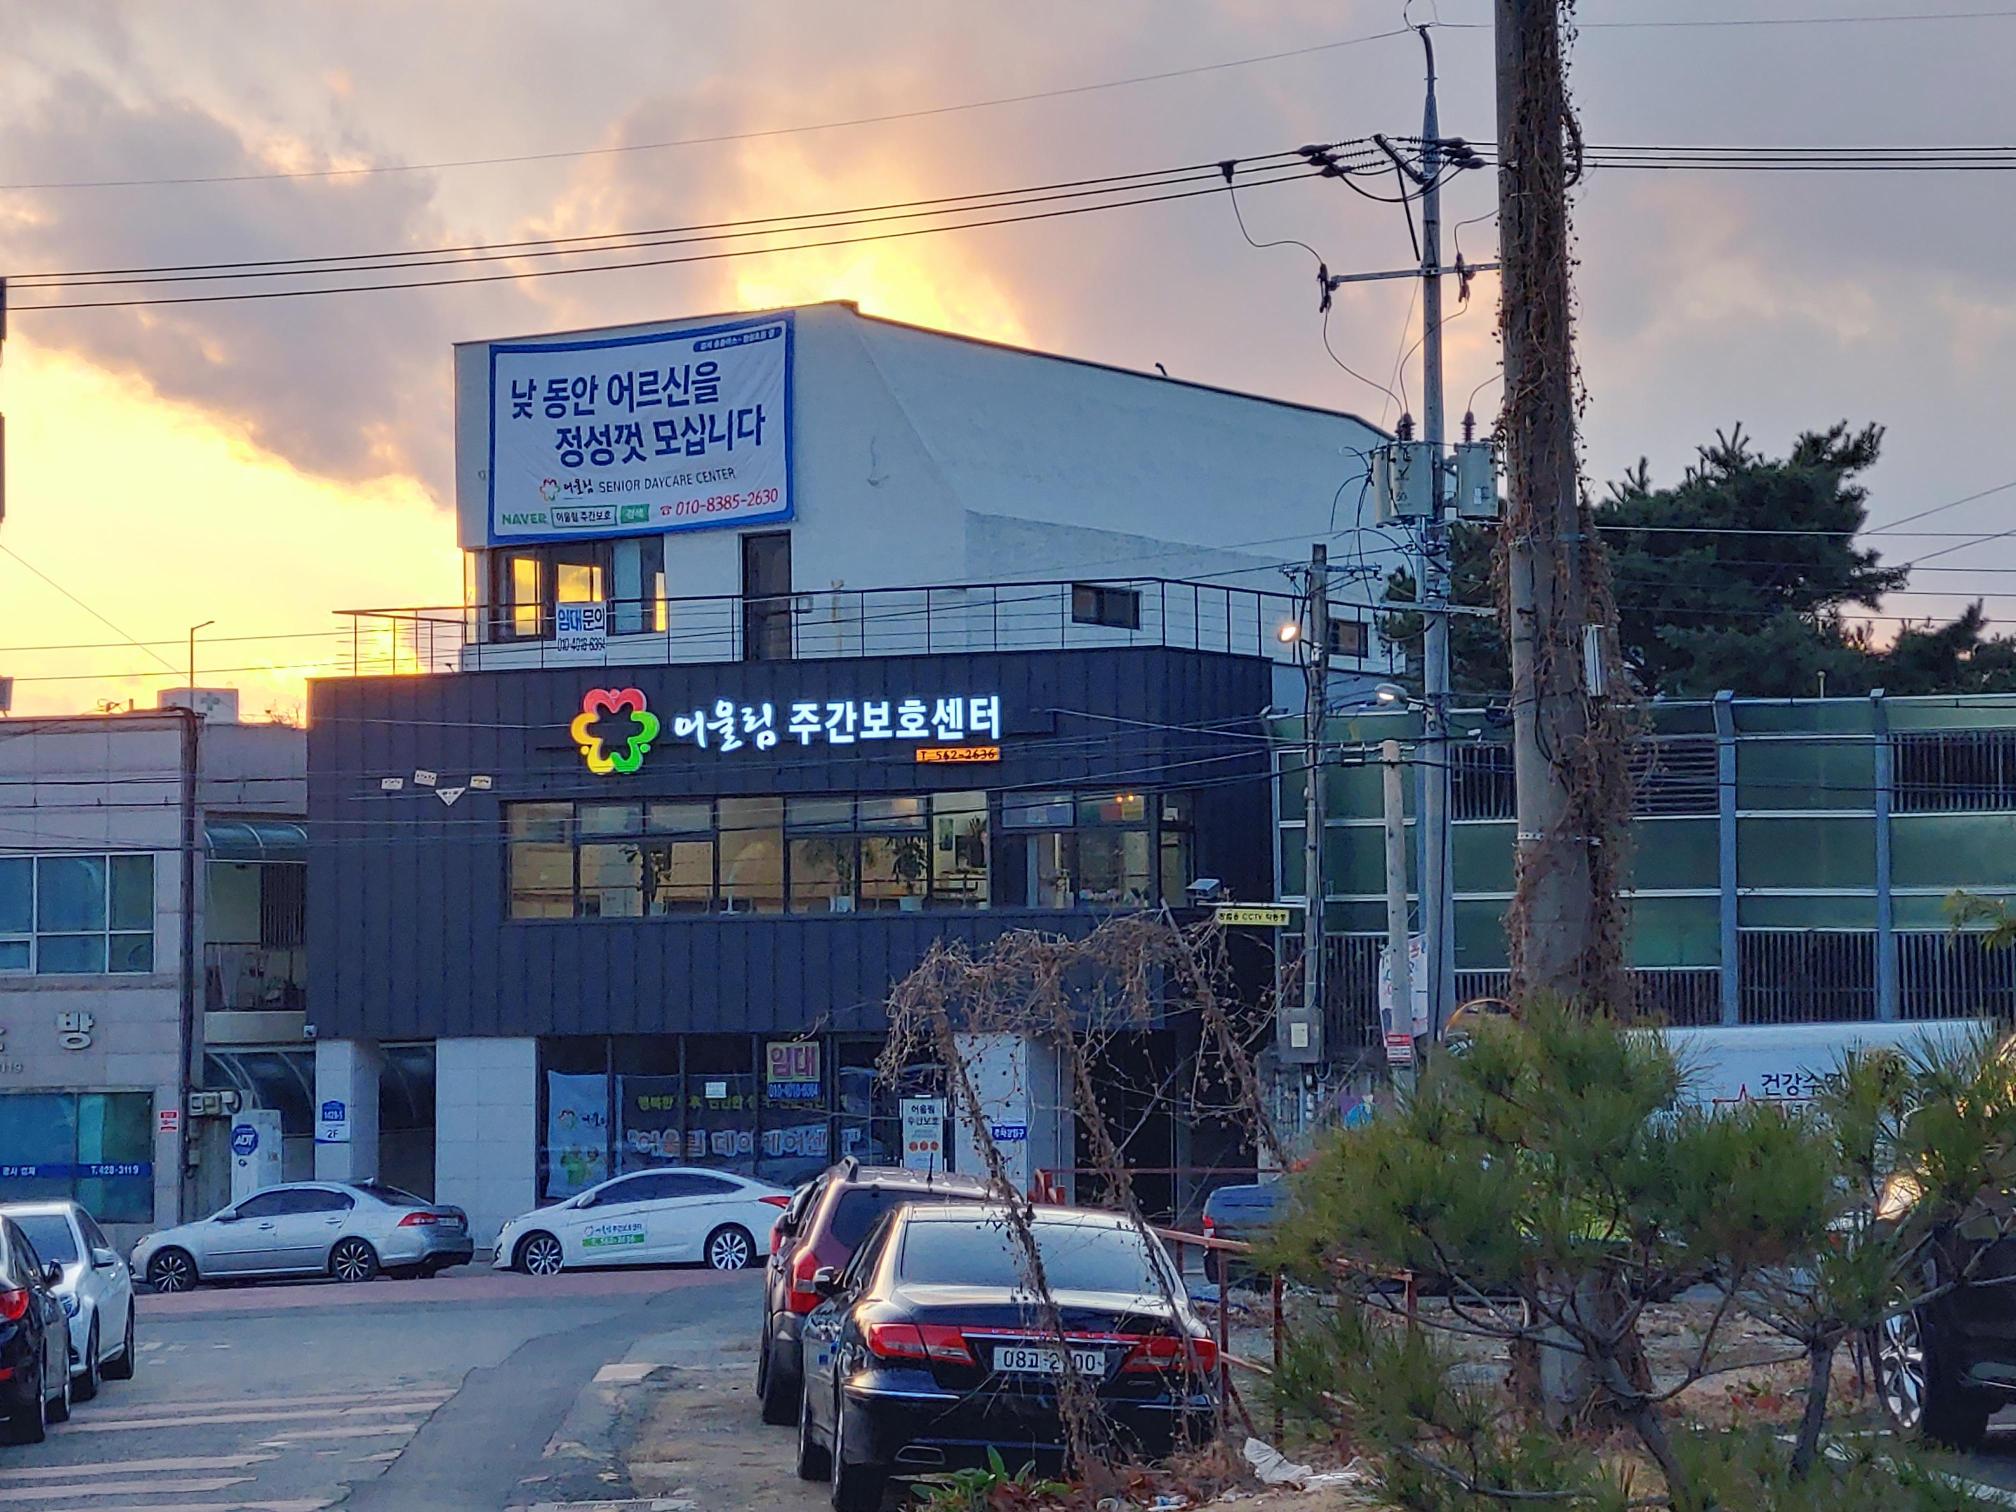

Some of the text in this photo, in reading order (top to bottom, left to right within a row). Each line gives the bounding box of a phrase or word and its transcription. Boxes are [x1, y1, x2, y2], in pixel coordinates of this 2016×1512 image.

[511, 360, 722, 420] 낮 동안 어르신을
[555, 403, 766, 468] 정성껏 모십니다
[599, 479, 640, 494] SENIOR
[644, 474, 693, 491] DAYCARE
[696, 466, 736, 485] CENTER
[675, 487, 779, 517] 010-8385-2630
[501, 512, 547, 526] NAVER
[558, 608, 605, 632] 임대문의
[673, 695, 999, 752] 어울림 주간보호센터
[770, 1047, 817, 1079] 임대
[234, 1134, 255, 1147] ADT
[327, 1129, 339, 1139] 2F
